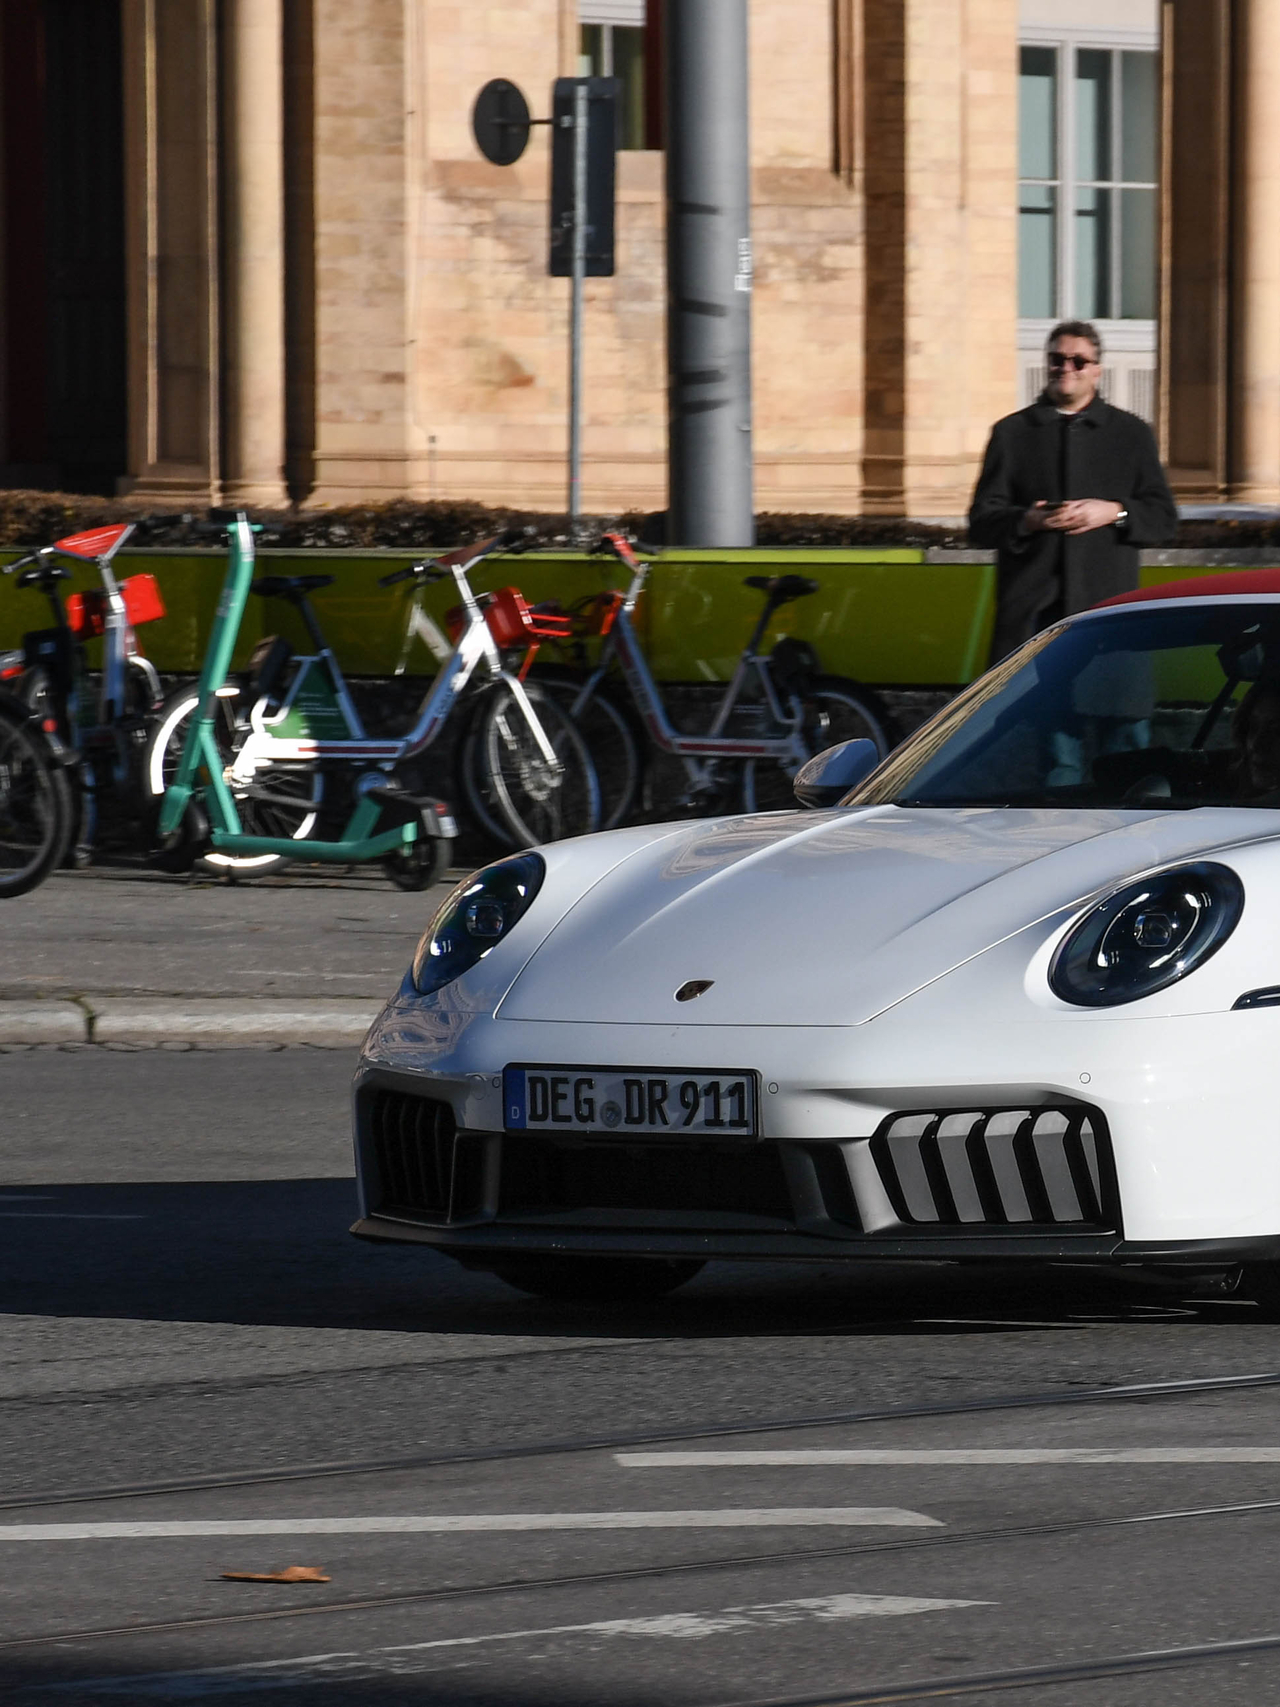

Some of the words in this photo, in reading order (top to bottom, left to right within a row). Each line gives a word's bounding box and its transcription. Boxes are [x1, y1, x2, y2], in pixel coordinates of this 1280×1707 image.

[511, 1106, 520, 1119] D
[528, 1076, 595, 1123] DEG
[623, 1078, 669, 1126] DR
[679, 1081, 749, 1128] 911
